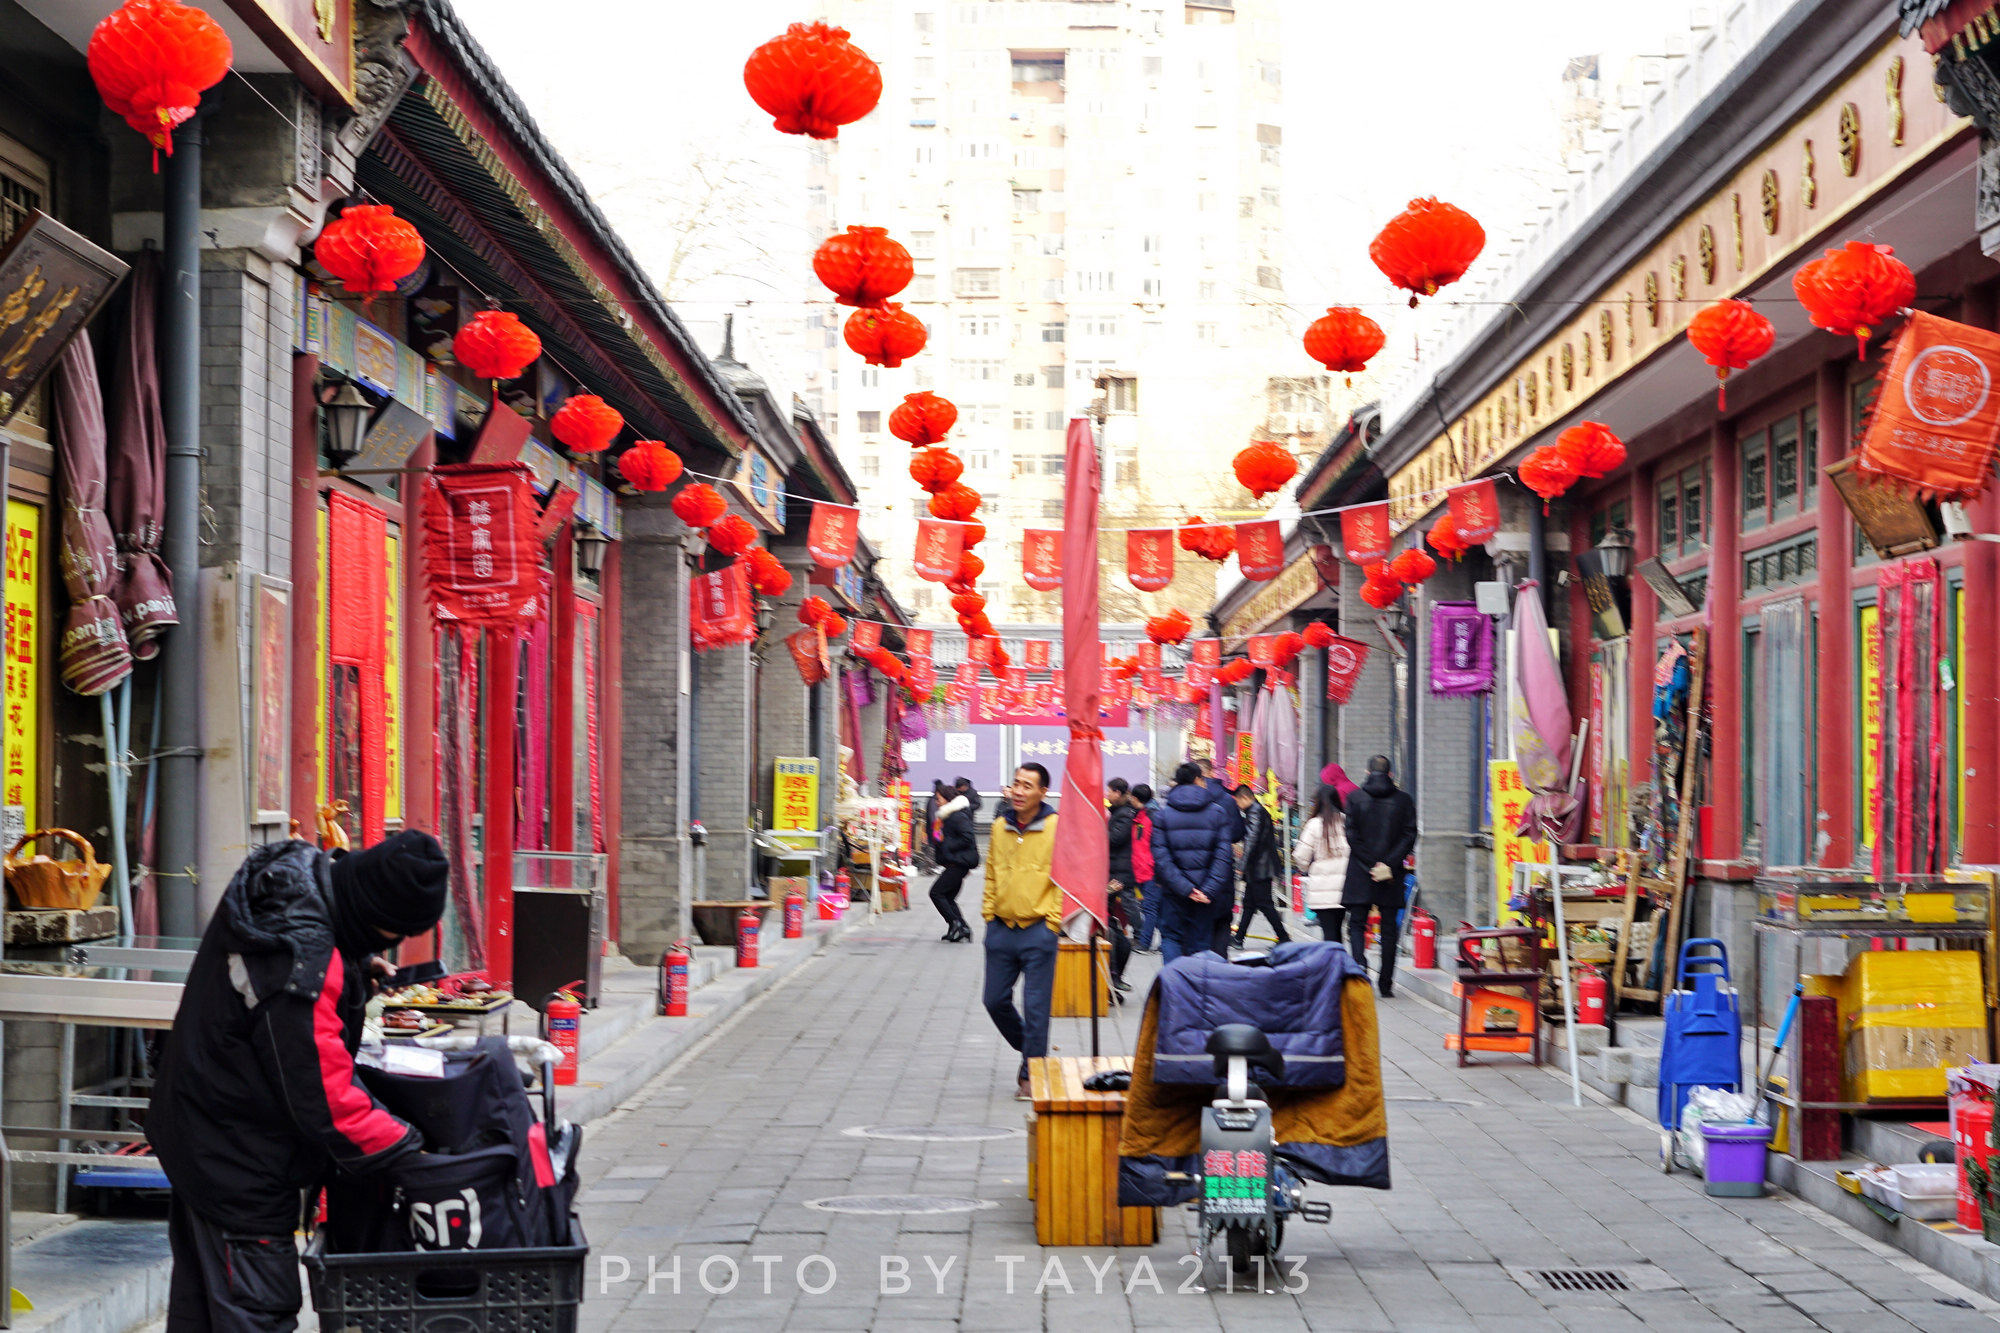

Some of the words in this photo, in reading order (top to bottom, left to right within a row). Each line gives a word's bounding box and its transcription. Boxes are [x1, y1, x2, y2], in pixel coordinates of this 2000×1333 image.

[781, 775, 811, 830] 原石加工
[1204, 1149, 1268, 1177] 绿能
